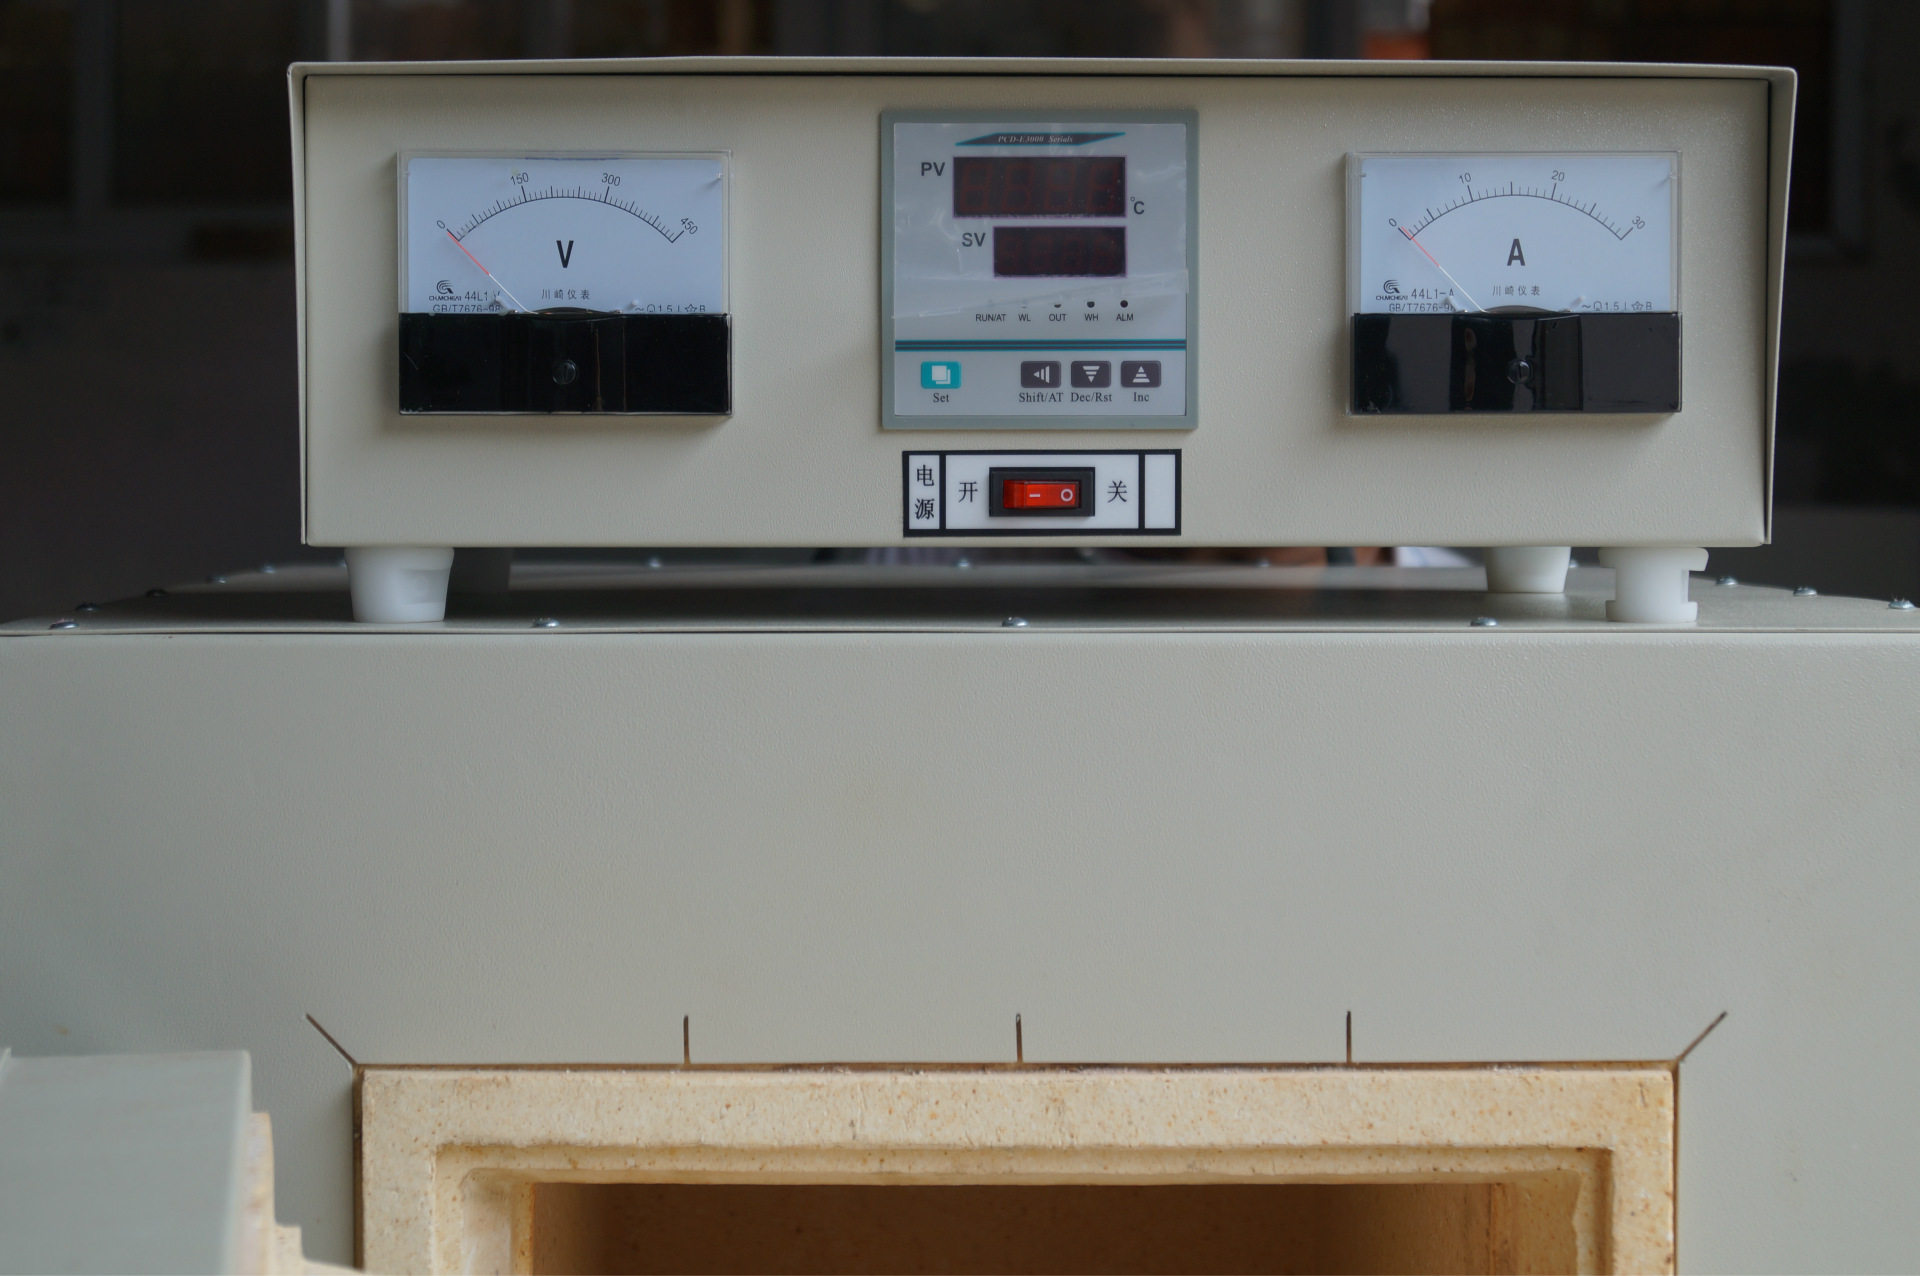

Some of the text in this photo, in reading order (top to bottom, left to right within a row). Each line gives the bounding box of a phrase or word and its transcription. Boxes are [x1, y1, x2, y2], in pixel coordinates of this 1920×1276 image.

[1048, 135, 1073, 143] Serials
[920, 162, 946, 177] PV
[510, 172, 529, 185] 150
[601, 172, 621, 186] 300
[1459, 172, 1472, 184] 10
[1551, 170, 1565, 182] 20
[436, 219, 446, 230] 0
[680, 216, 698, 235] 450
[1388, 217, 1398, 228] 0
[1631, 215, 1646, 230] 30
[961, 232, 986, 247] SV
[556, 240, 574, 268] V
[1507, 238, 1526, 266] A
[975, 313, 1007, 322] RUN/AT
[1018, 313, 1031, 322] WL
[1048, 313, 1067, 322] OUT
[1084, 313, 1099, 321] WH
[1116, 313, 1134, 321] ALM
[932, 392, 950, 403] Set
[1018, 391, 1064, 403] Shift/AT
[1070, 391, 1112, 403] Dec/Rst
[1133, 391, 1150, 402] Inc
[958, 481, 978, 503] 开
[1107, 480, 1128, 503] 关
